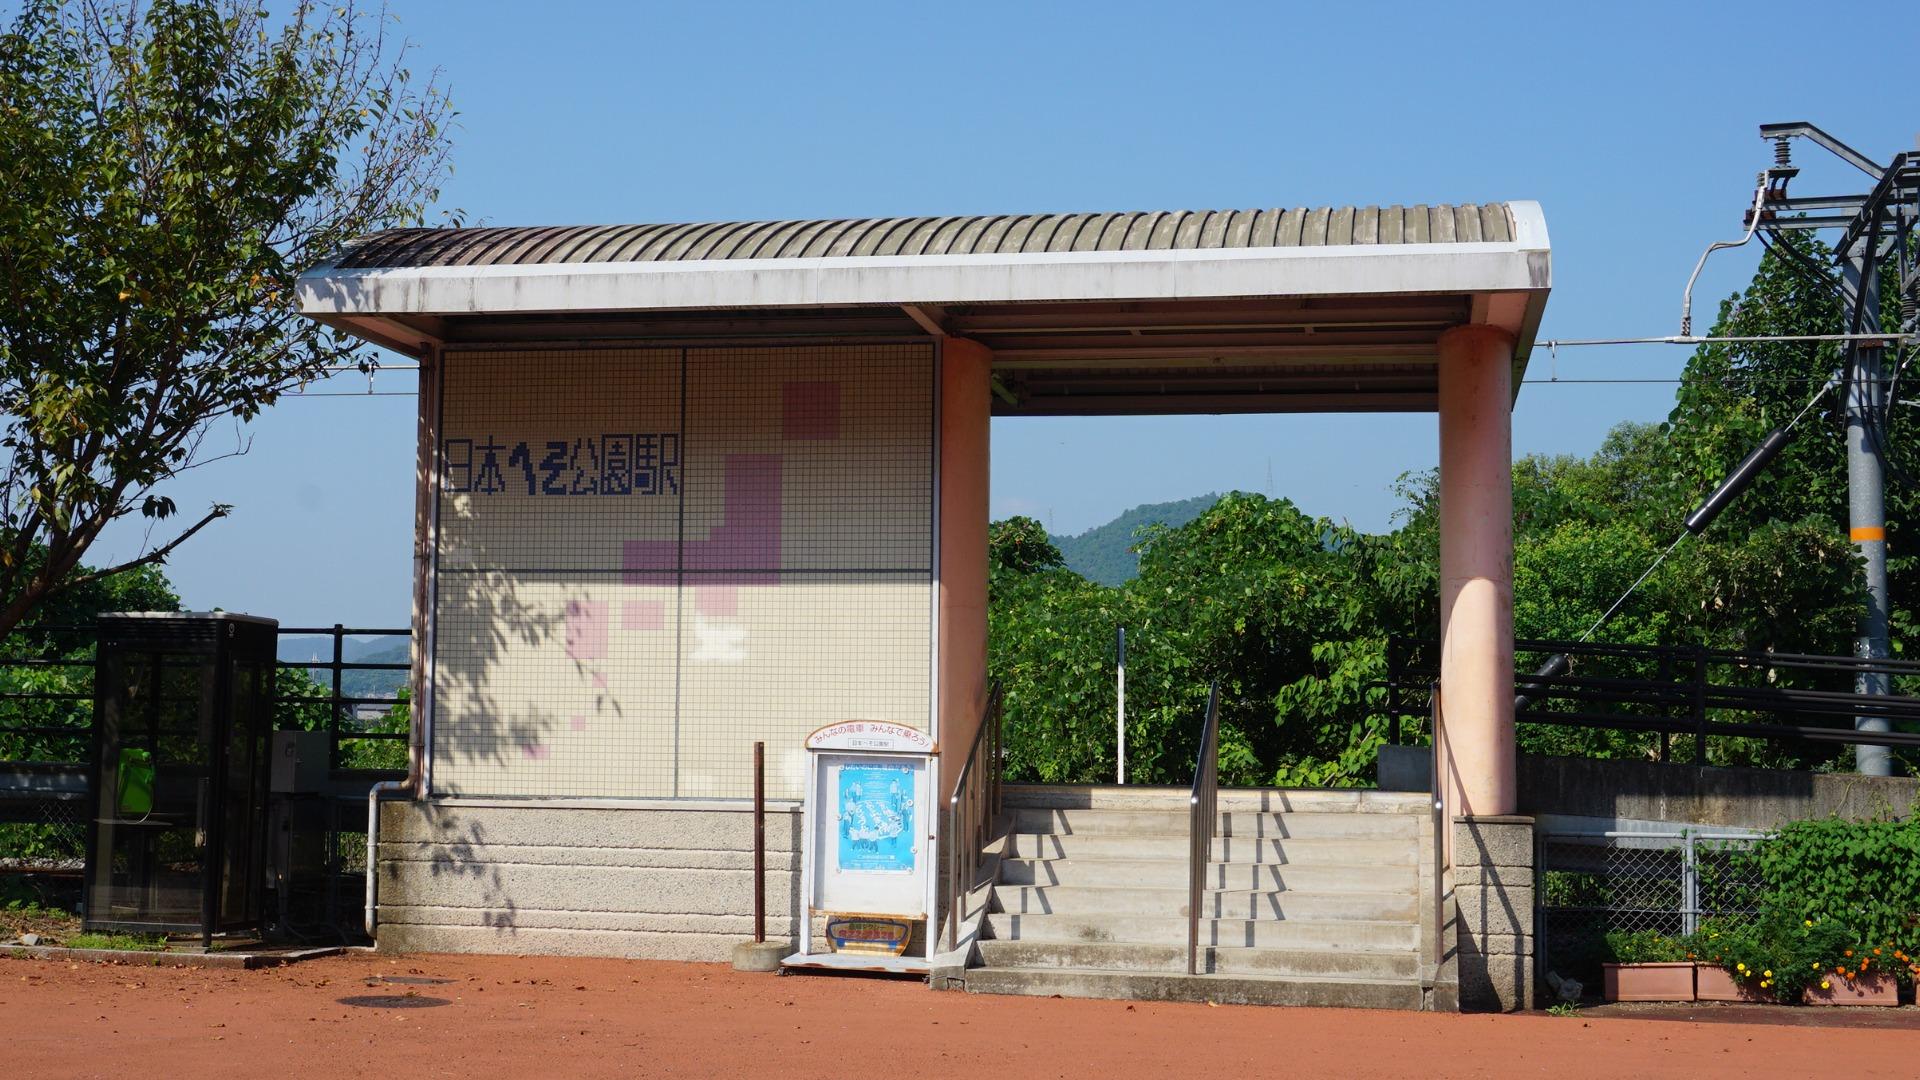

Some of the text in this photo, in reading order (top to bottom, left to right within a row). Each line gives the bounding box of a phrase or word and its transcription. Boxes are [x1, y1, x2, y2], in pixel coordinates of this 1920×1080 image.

[444, 433, 679, 496] 日本へそ公園駅
